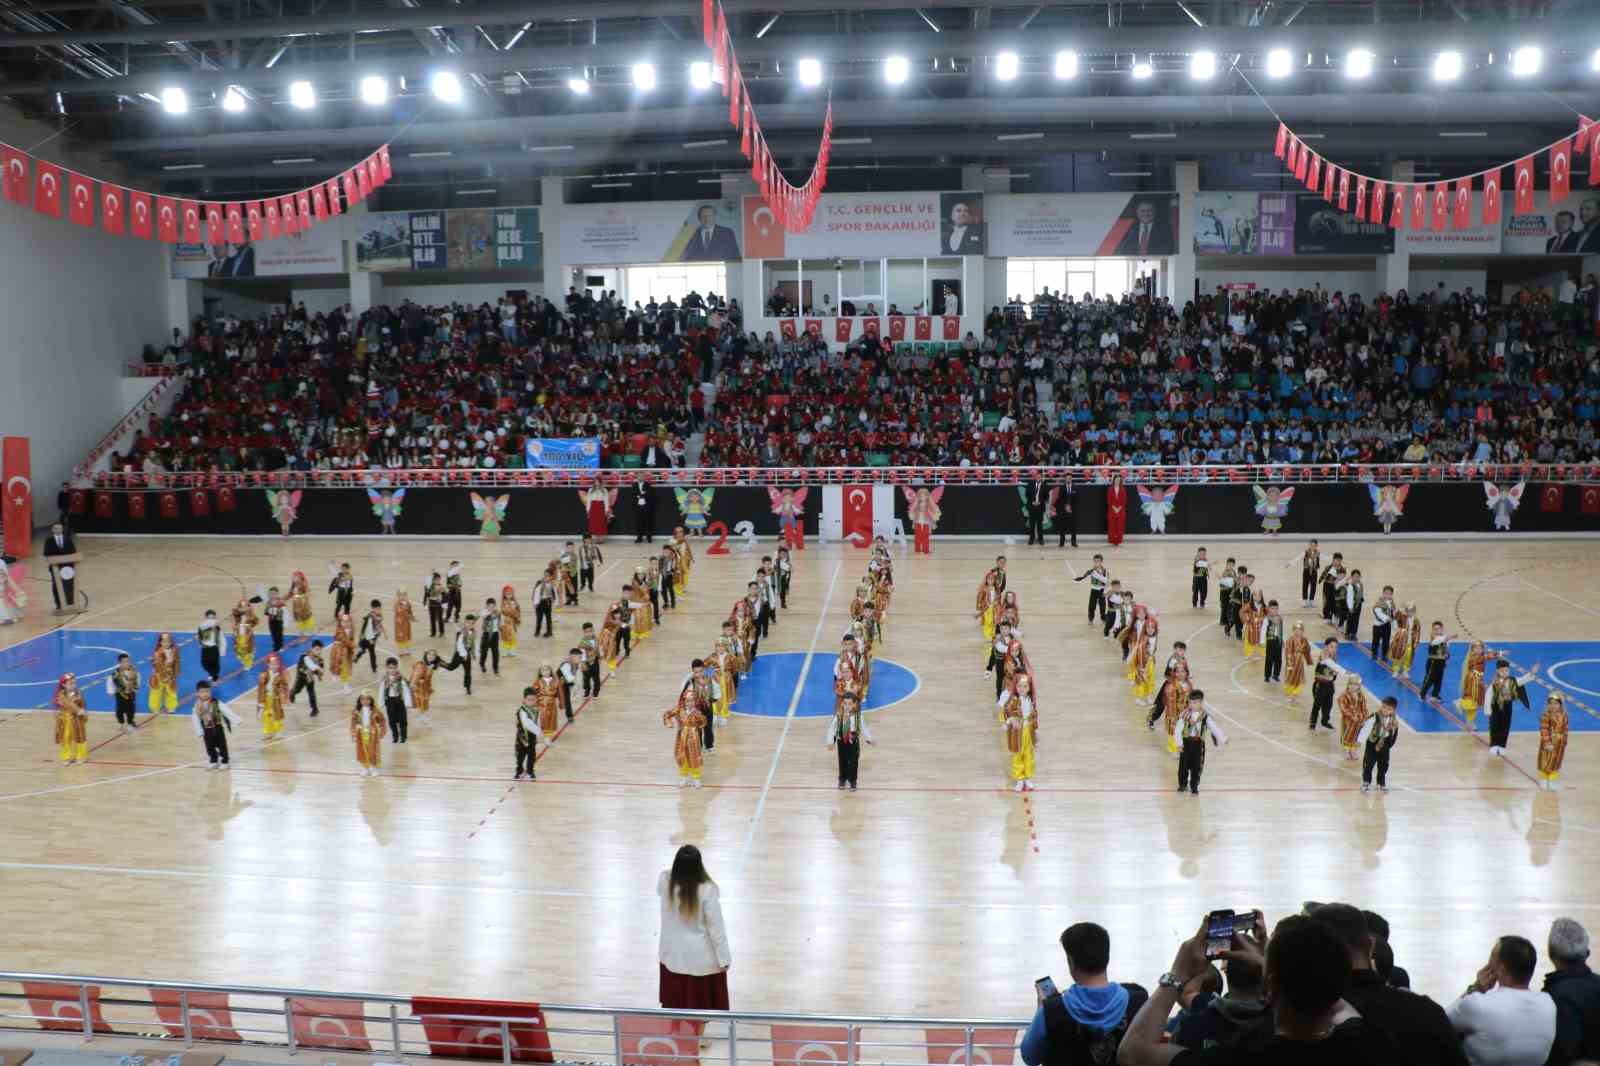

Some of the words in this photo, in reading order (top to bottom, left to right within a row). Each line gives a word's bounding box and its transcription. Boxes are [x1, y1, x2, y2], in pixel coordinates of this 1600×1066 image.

[826, 205, 850, 215] T.C.
[854, 203, 913, 217] GENÇLİK
[917, 203, 936, 214] VE
[827, 221, 862, 232] SPOR
[865, 218, 936, 232] BAKANLIĞI
[706, 520, 758, 554] 23
